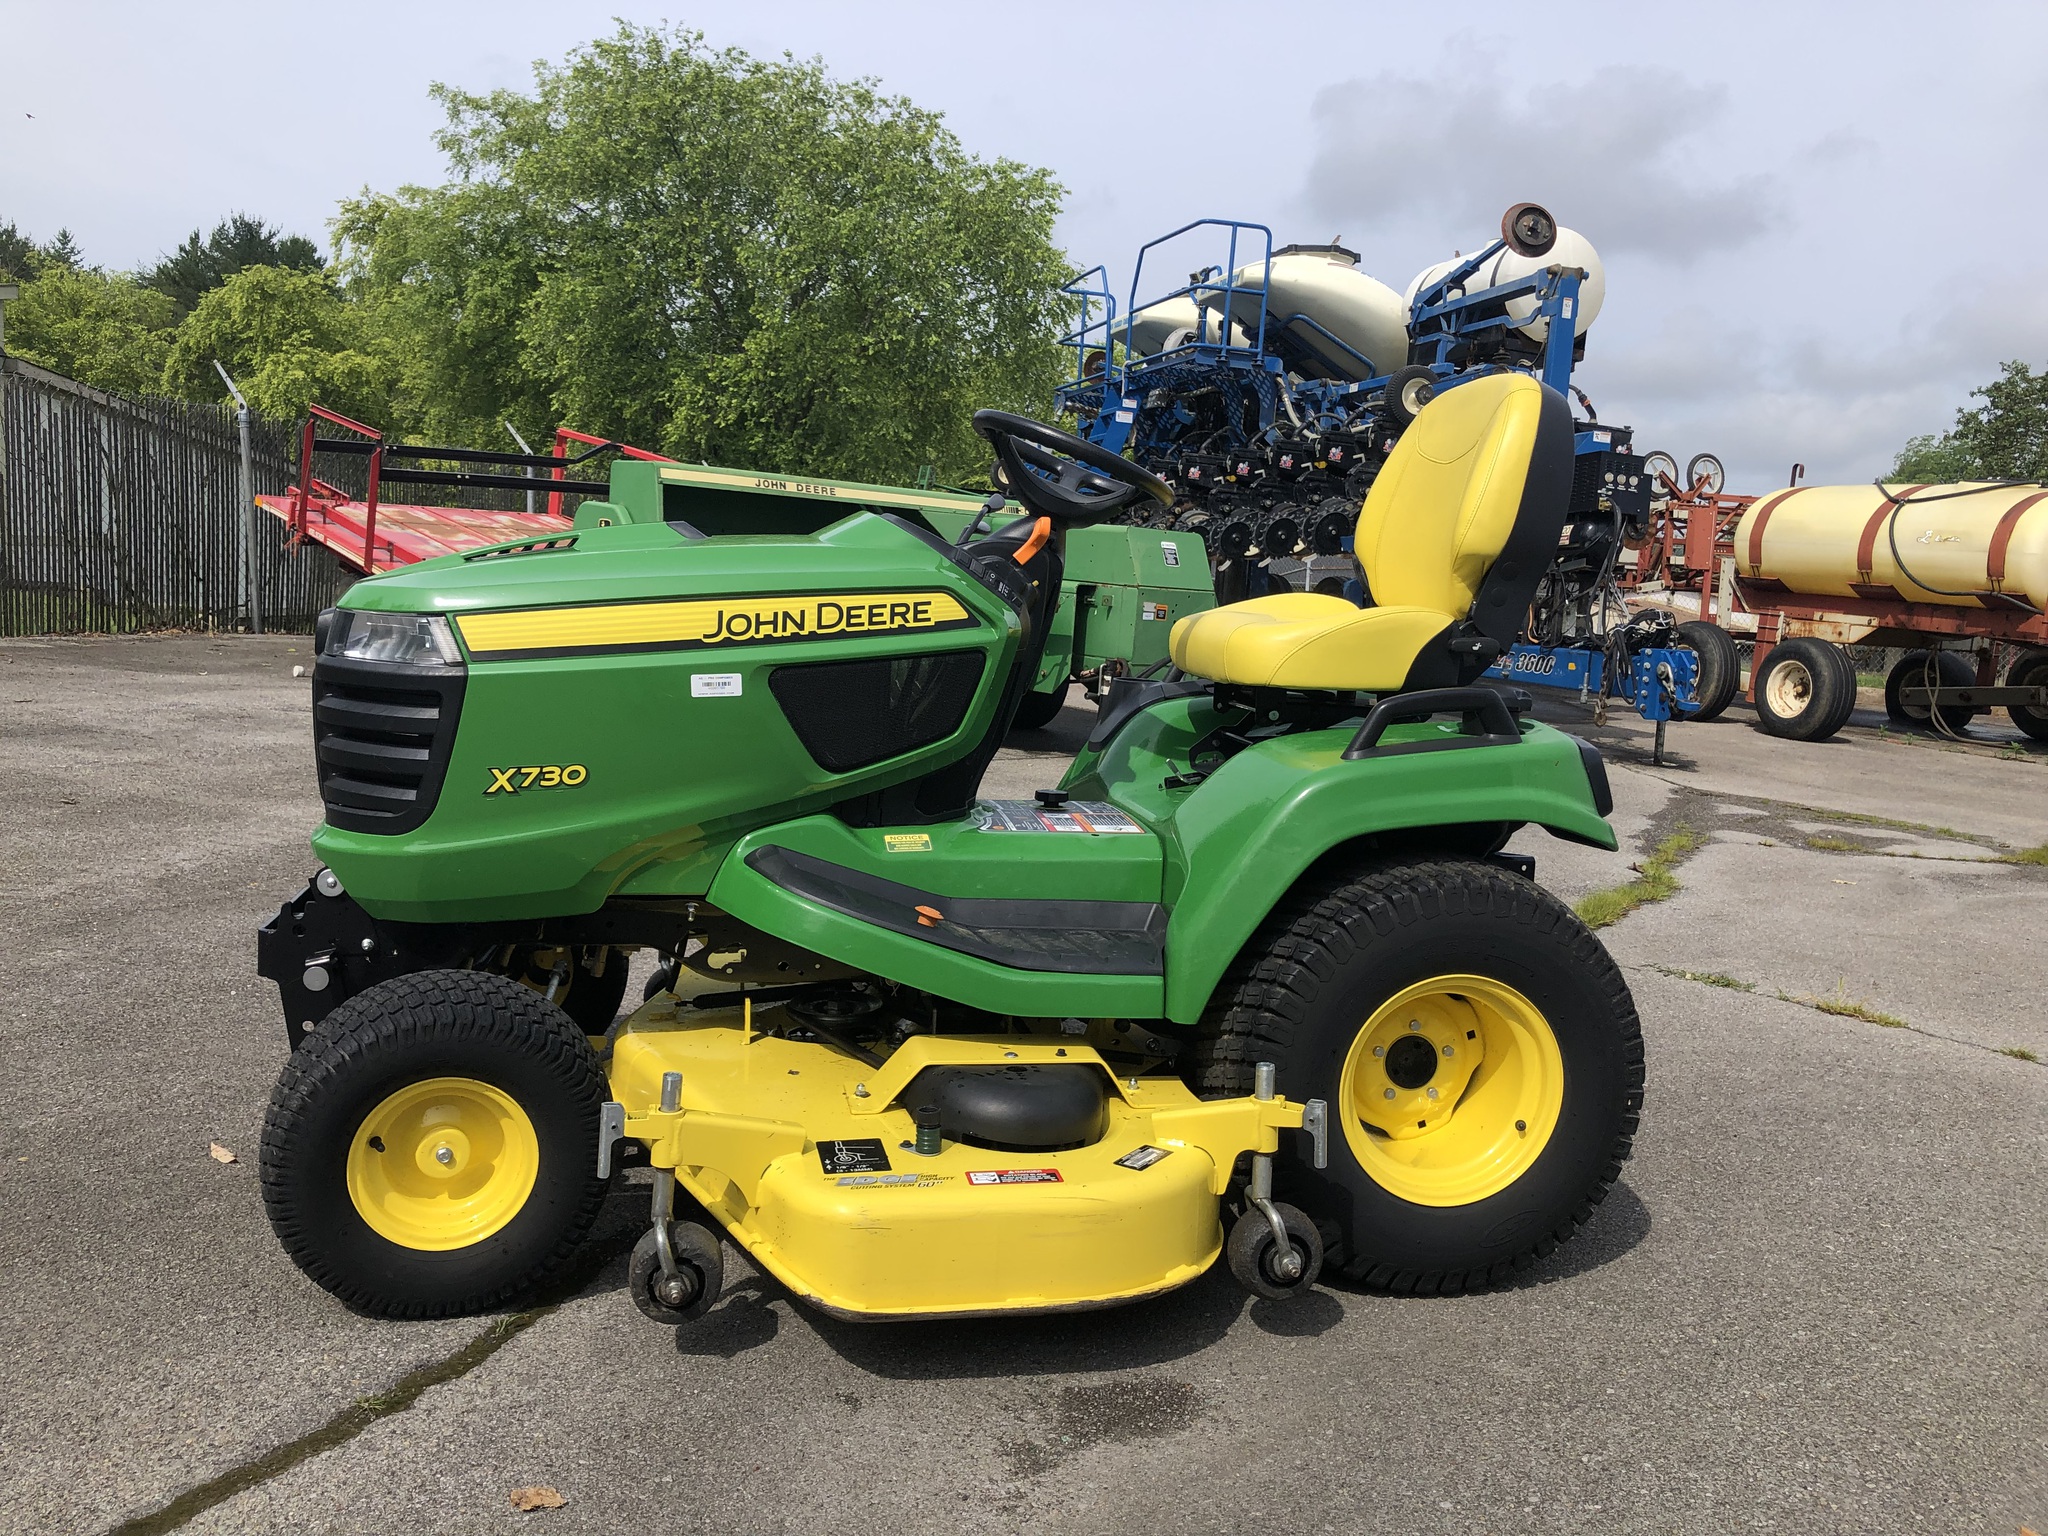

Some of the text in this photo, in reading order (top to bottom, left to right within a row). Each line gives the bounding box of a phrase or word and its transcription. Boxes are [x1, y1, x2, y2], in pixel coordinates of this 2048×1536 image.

[755, 479, 837, 496] JOHN DEERE
[702, 600, 932, 640] JOHN DEERE
[1514, 652, 1556, 675] 3600
[482, 764, 588, 794] X730
